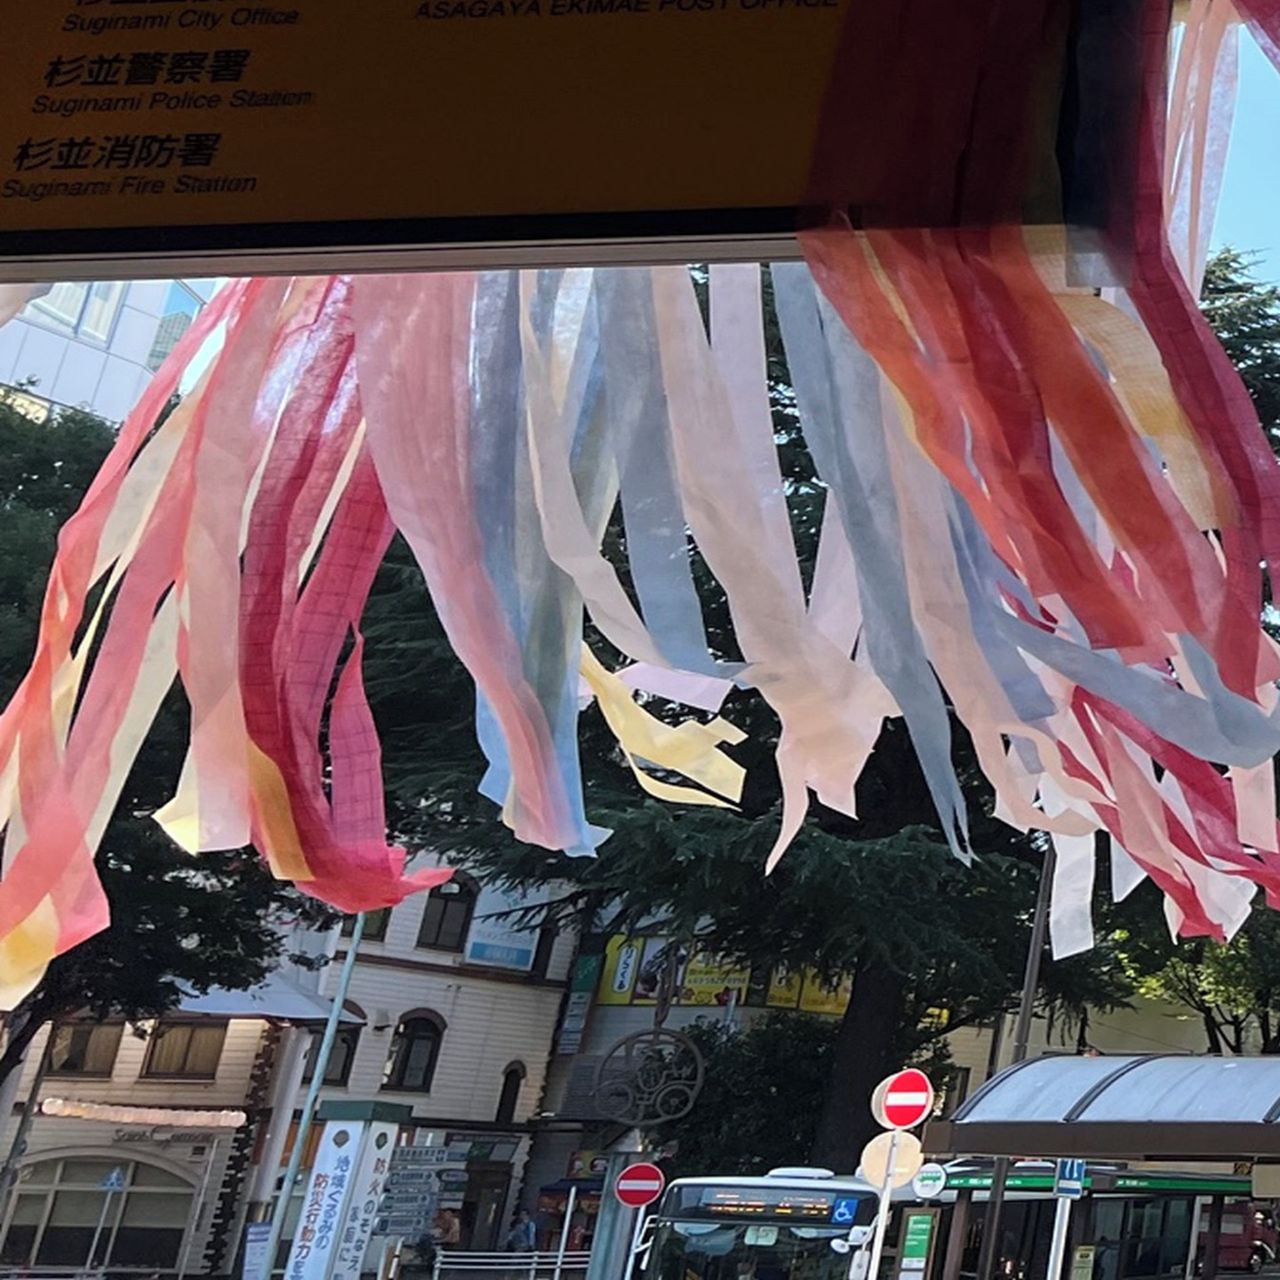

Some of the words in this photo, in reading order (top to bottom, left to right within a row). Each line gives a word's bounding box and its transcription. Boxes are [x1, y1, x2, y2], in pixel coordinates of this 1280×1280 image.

[62, 12, 170, 35] Suginami
[178, 8, 225, 31] City
[231, 6, 300, 27] Office
[417, 0, 542, 20] ASAGAYA
[43, 50, 252, 89] 杉並警察署
[32, 94, 142, 117] Suginami
[148, 91, 222, 111] Police
[230, 89, 314, 109] Station
[13, 133, 222, 172] 杉並消防署
[1, 178, 112, 202] Suginami
[119, 175, 165, 195] Fire
[173, 174, 258, 195] Station
